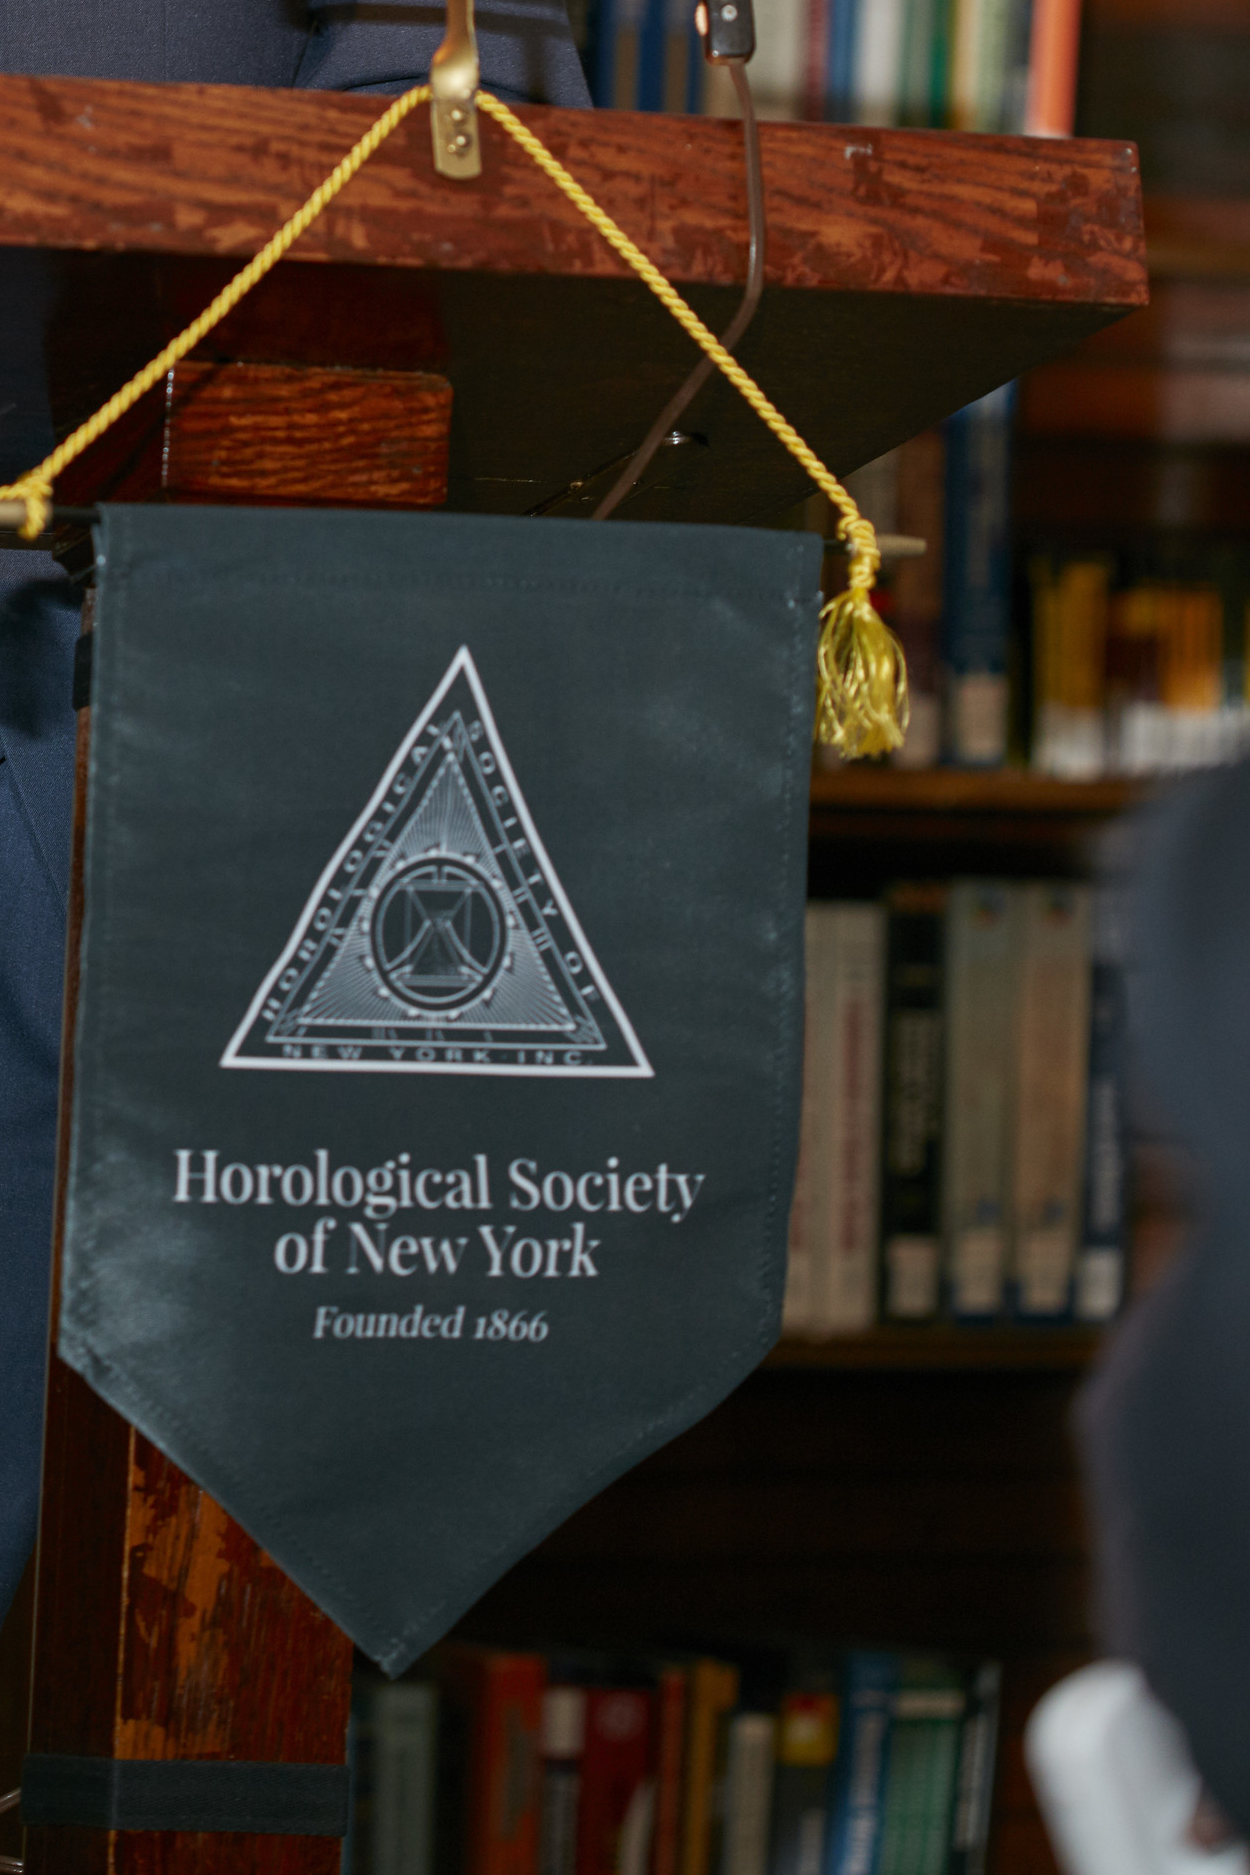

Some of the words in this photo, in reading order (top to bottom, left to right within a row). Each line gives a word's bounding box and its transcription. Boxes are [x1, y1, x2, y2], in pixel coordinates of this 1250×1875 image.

[261, 721, 447, 1022] HOROLOGICAL
[469, 720, 558, 916] SOCIETY
[563, 950, 600, 1002] OF
[282, 1043, 363, 1060] NEW
[388, 1046, 492, 1063] YORK
[173, 1148, 494, 1220] Horological
[508, 1154, 706, 1223] Society
[273, 1217, 337, 1274] of
[345, 1222, 469, 1277] New
[478, 1222, 602, 1278] York
[312, 1304, 466, 1339] Founded
[473, 1308, 550, 1342] 1866
